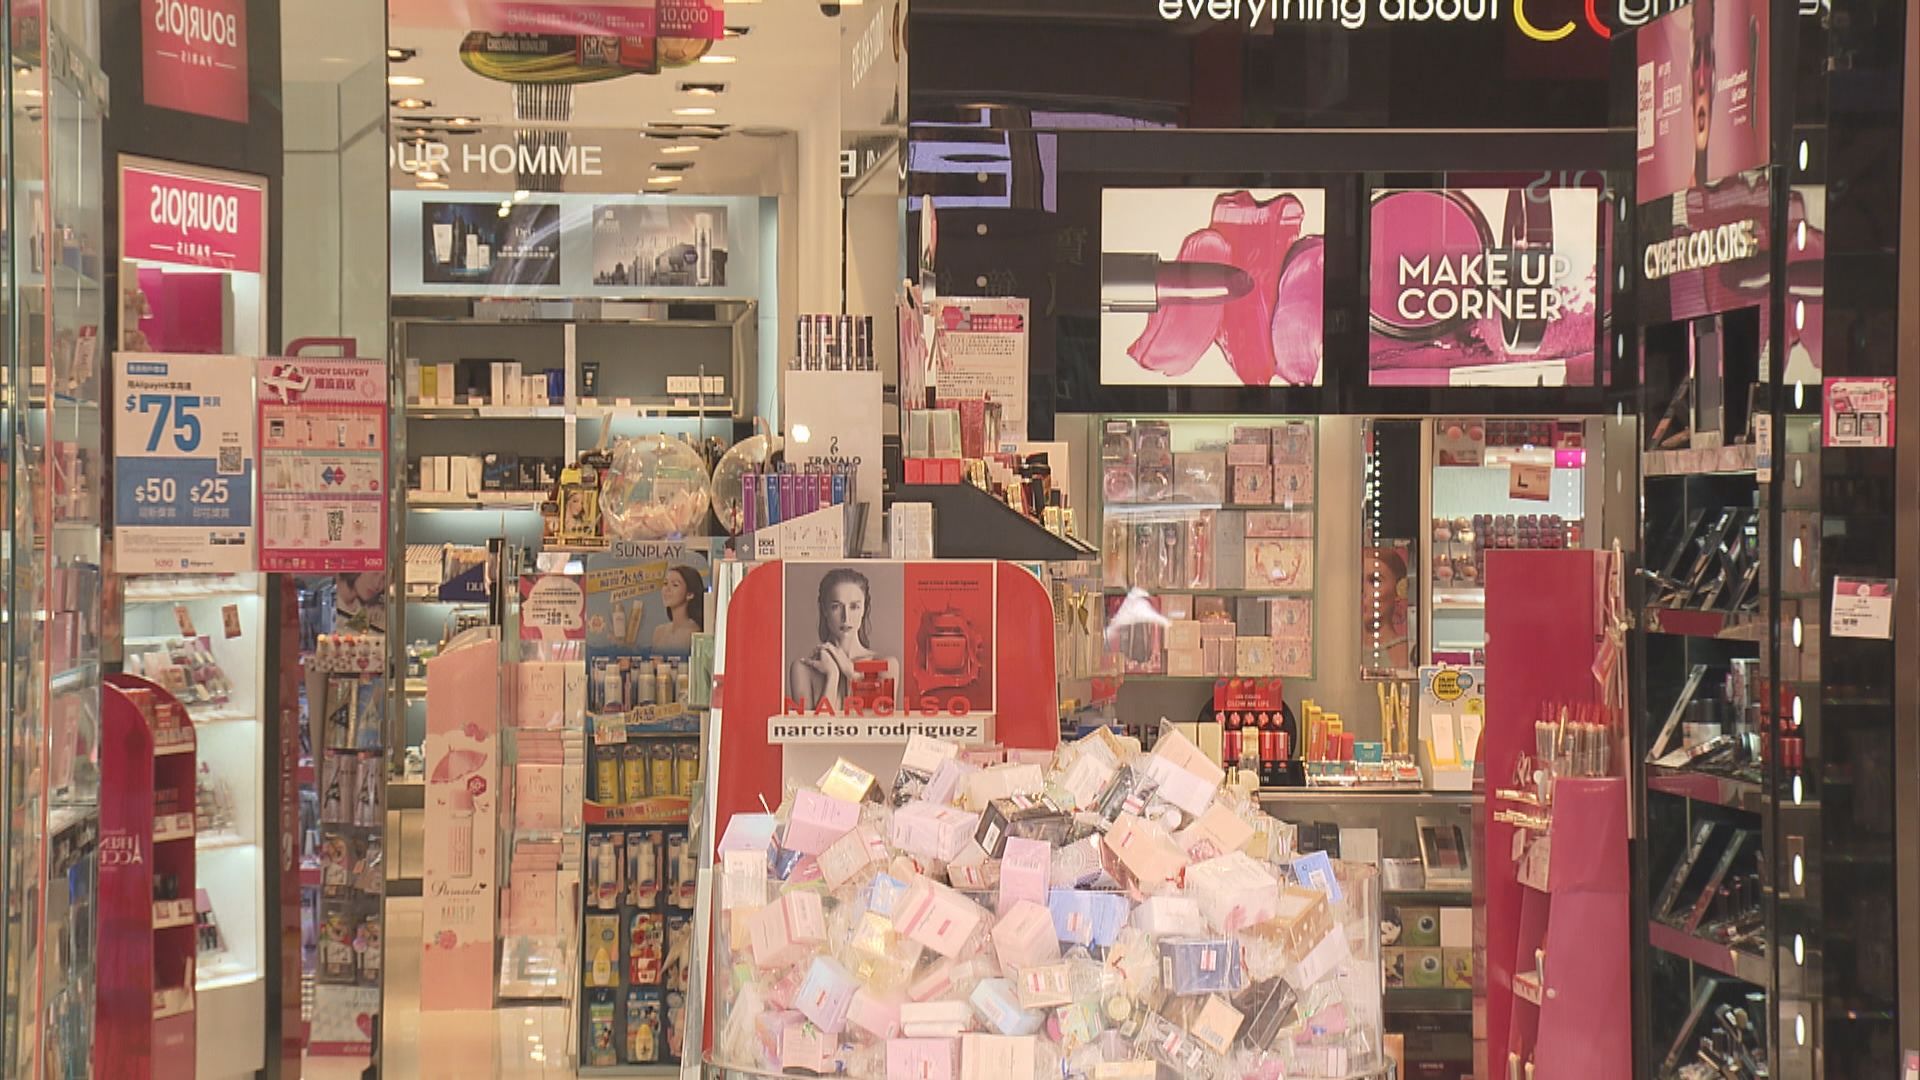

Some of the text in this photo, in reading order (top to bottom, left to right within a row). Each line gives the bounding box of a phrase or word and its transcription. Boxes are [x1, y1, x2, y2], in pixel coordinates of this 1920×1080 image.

[390, 144, 602, 176] UR HOMME
[1399, 254, 1571, 286] MAKE UP
[1397, 288, 1563, 321] CORNER
[333, 367, 369, 377] DELIVERY
[125, 394, 201, 453] $75
[808, 456, 861, 466] TRAVALO
[135, 478, 229, 503] $50 $25
[615, 542, 683, 559] SUNPLAY
[784, 695, 971, 718] NARCISO
[774, 721, 978, 738] narciso rodriguez
